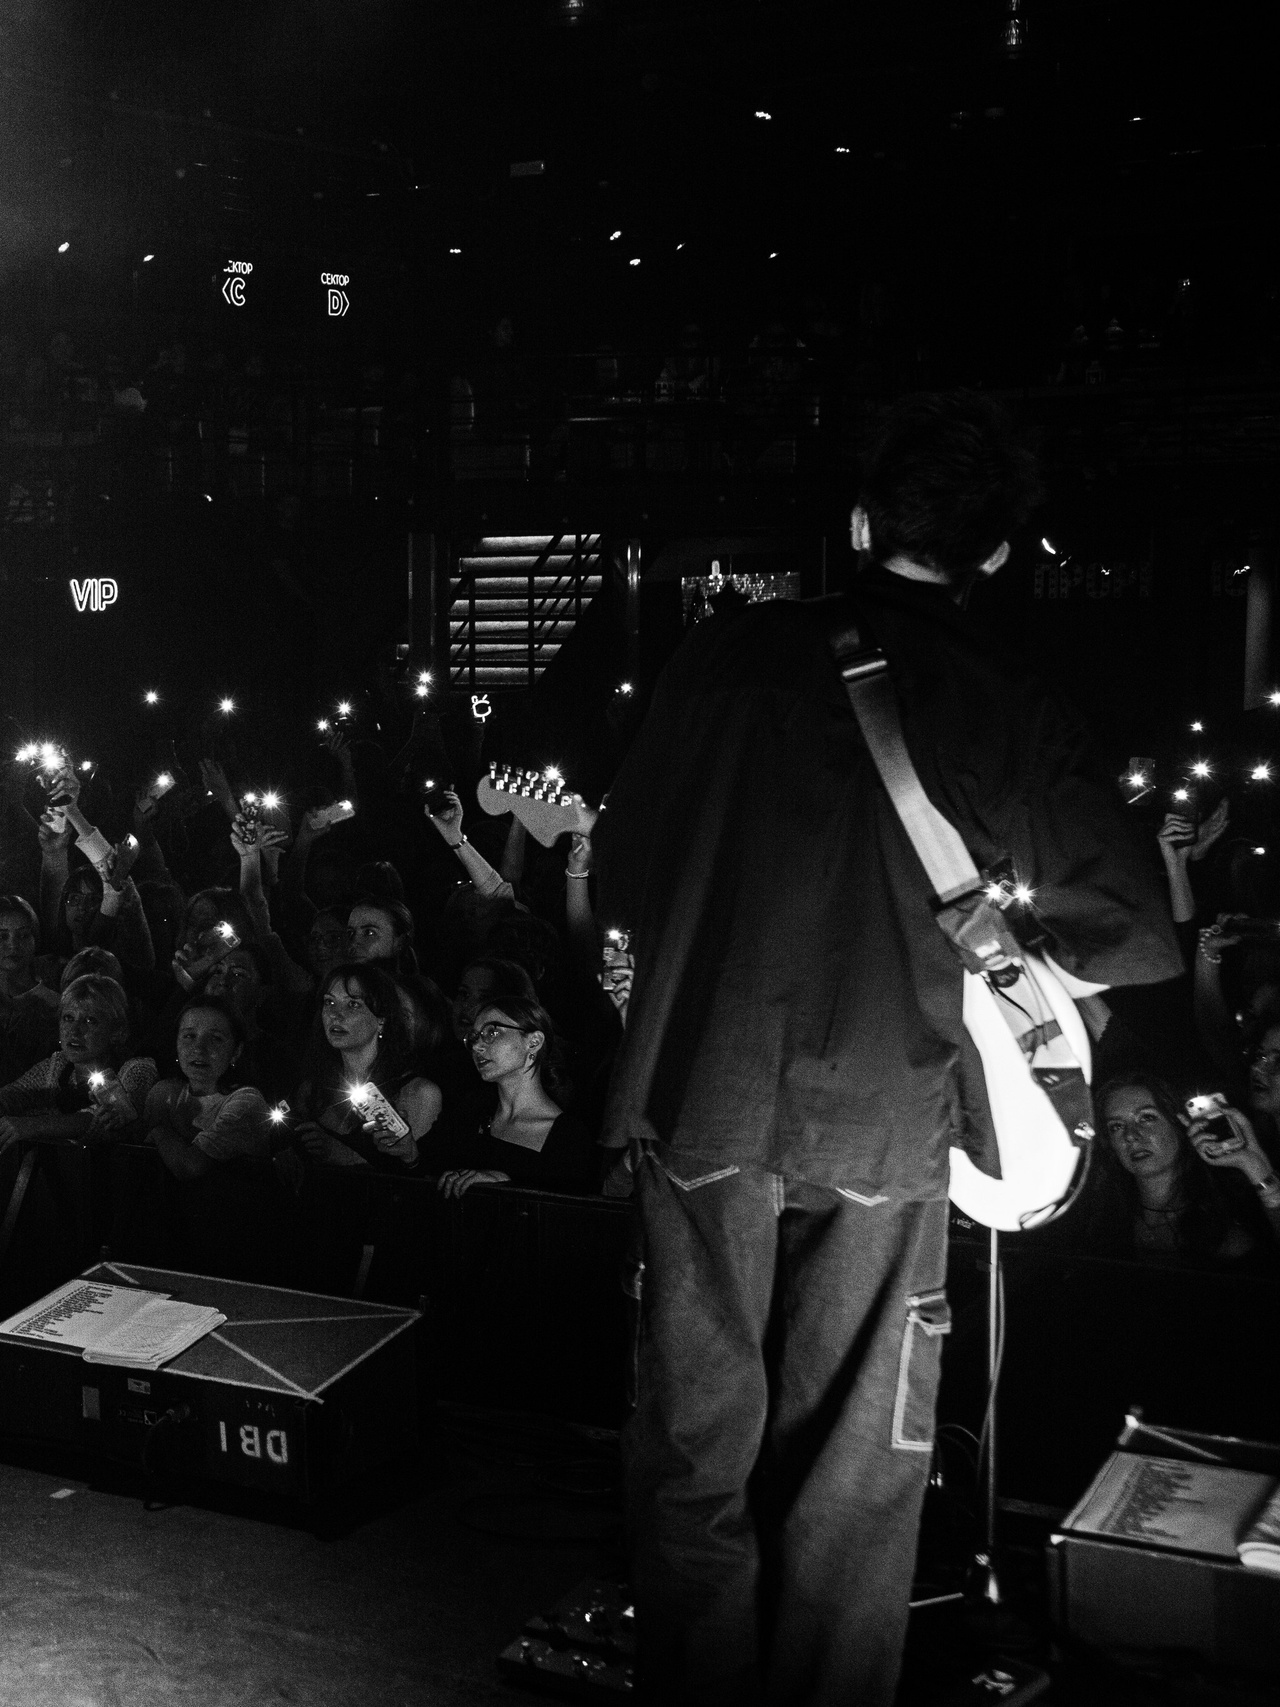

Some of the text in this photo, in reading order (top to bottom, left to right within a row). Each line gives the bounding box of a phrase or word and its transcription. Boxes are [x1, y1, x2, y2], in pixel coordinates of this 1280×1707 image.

[320, 272, 350, 286] СЕКТОР
[328, 289, 344, 316] D
[69, 578, 118, 612] VIP
